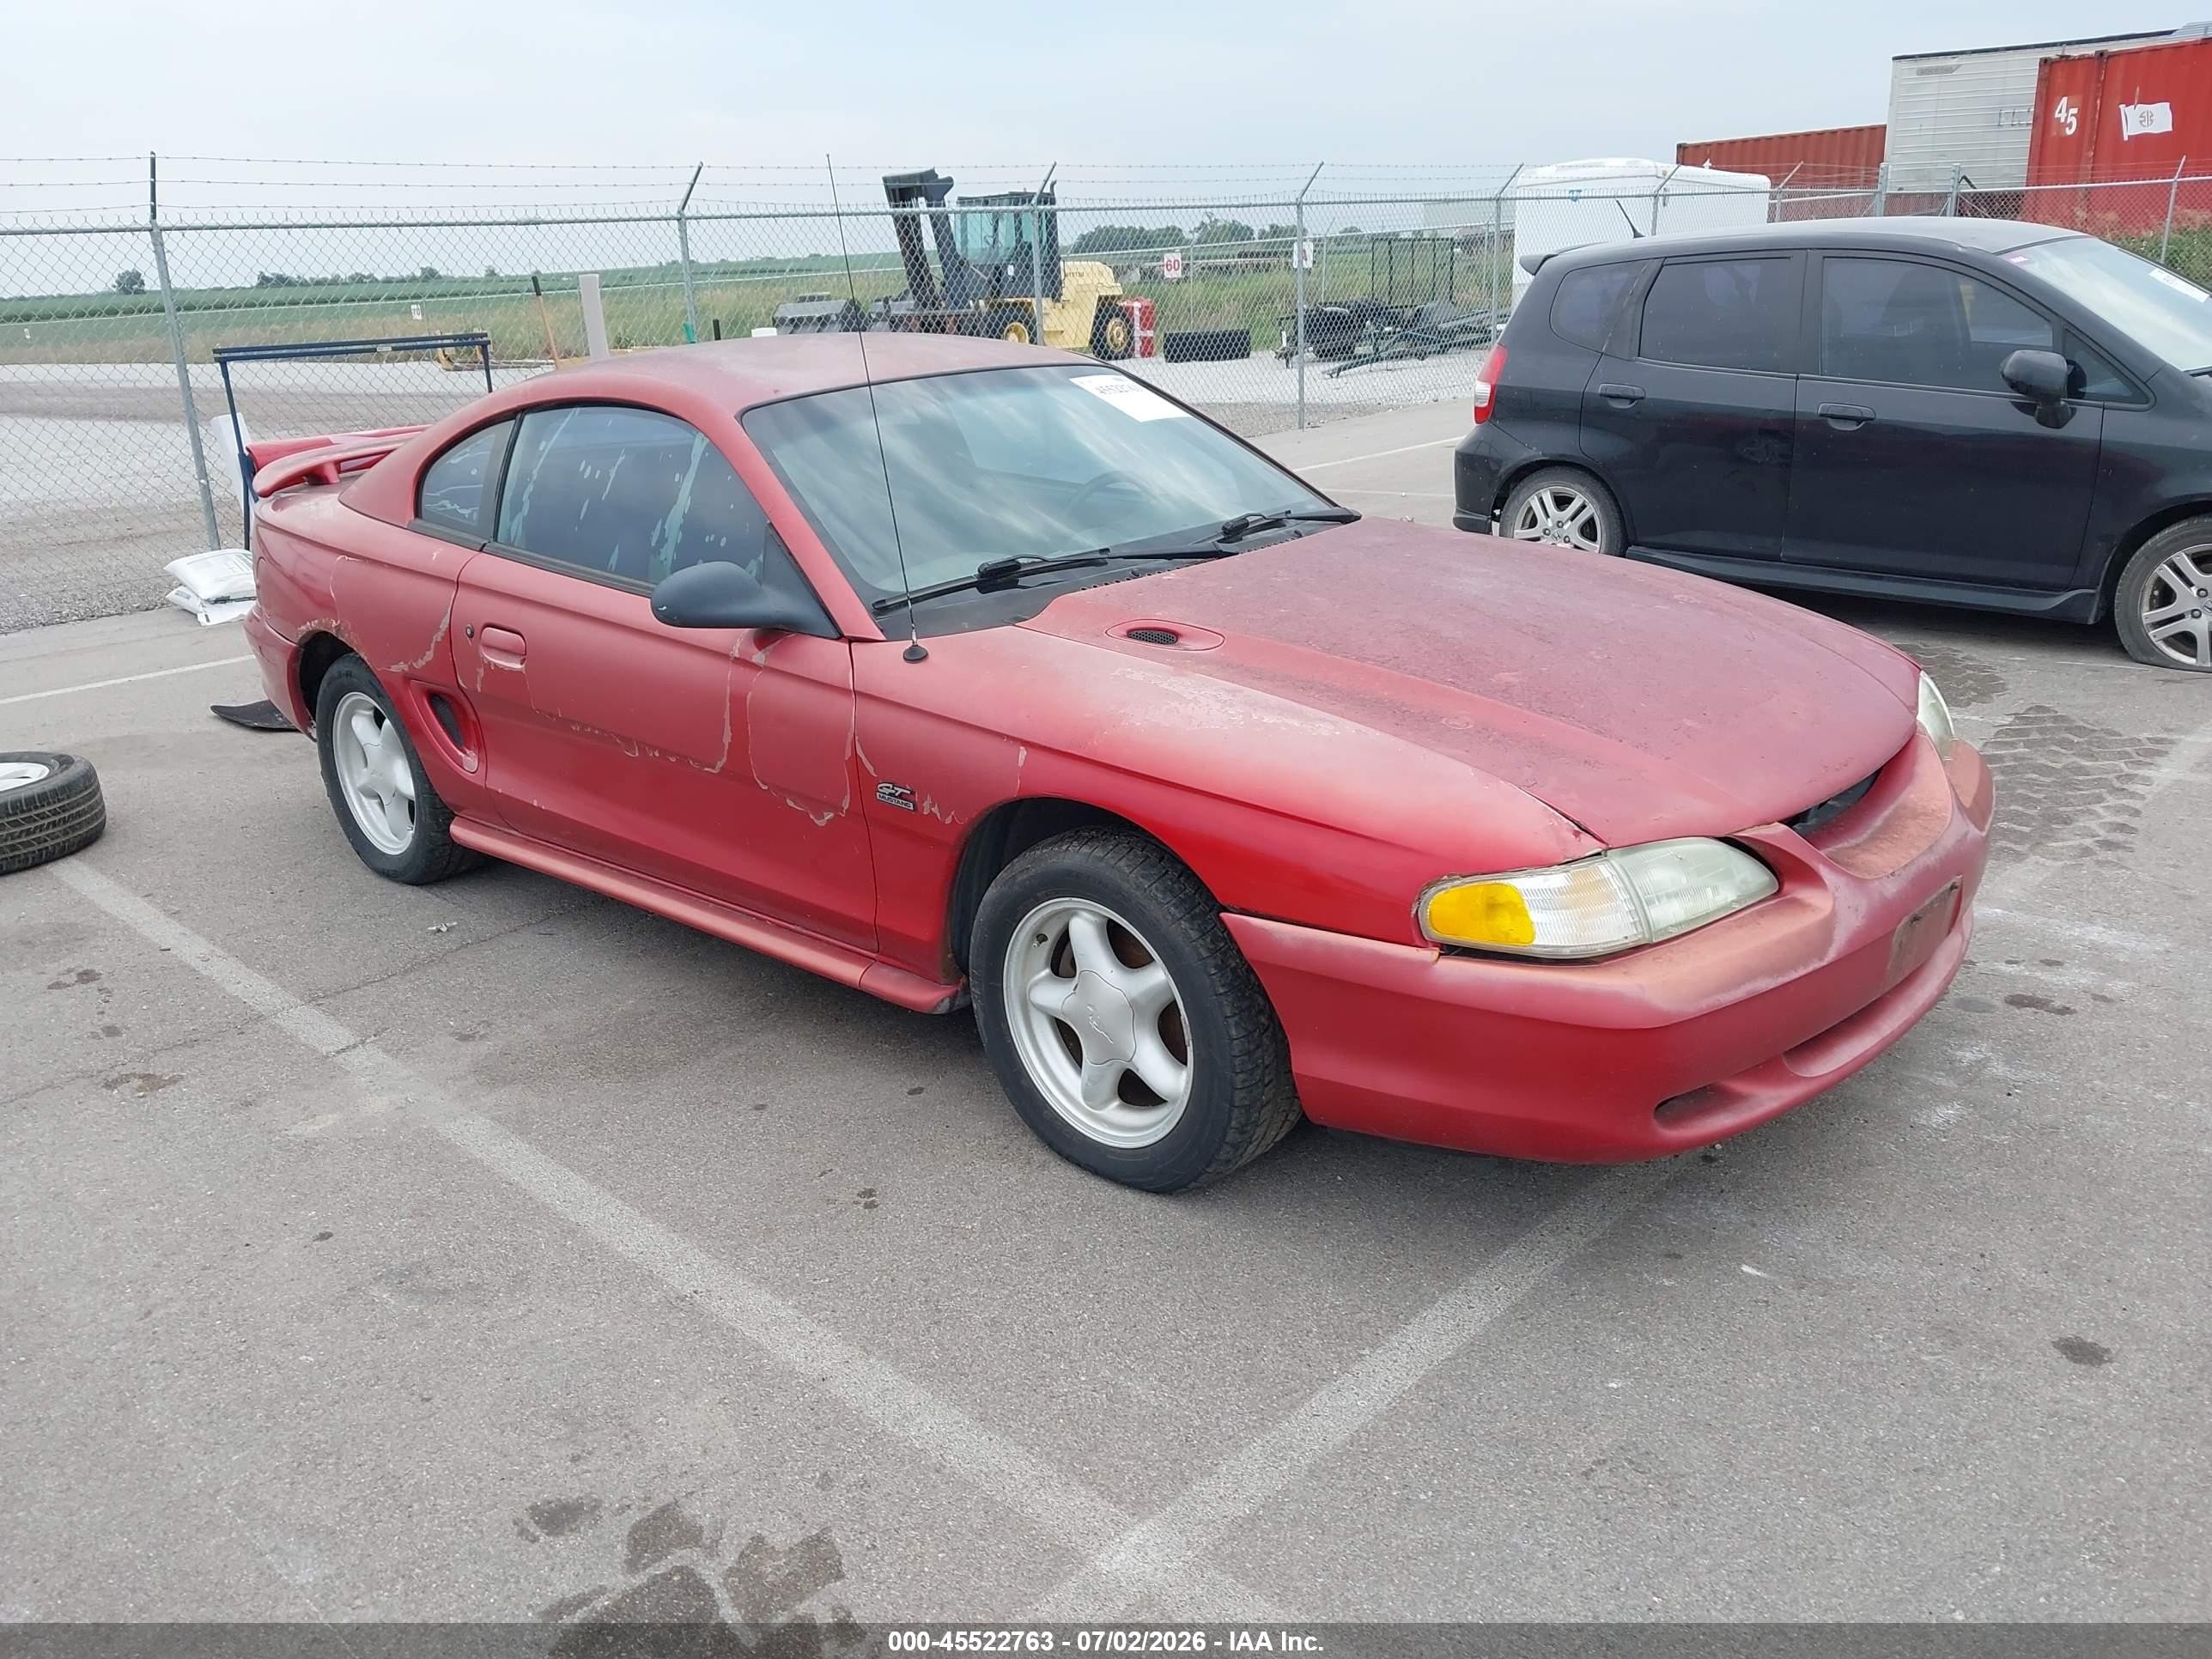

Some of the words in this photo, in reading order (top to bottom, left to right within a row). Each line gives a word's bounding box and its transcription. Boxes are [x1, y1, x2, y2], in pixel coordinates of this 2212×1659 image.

[2054, 96, 2078, 136] 45
[1165, 259, 1181, 271] 60
[877, 782, 911, 796] GT
[878, 793, 913, 808] MUSTANG
